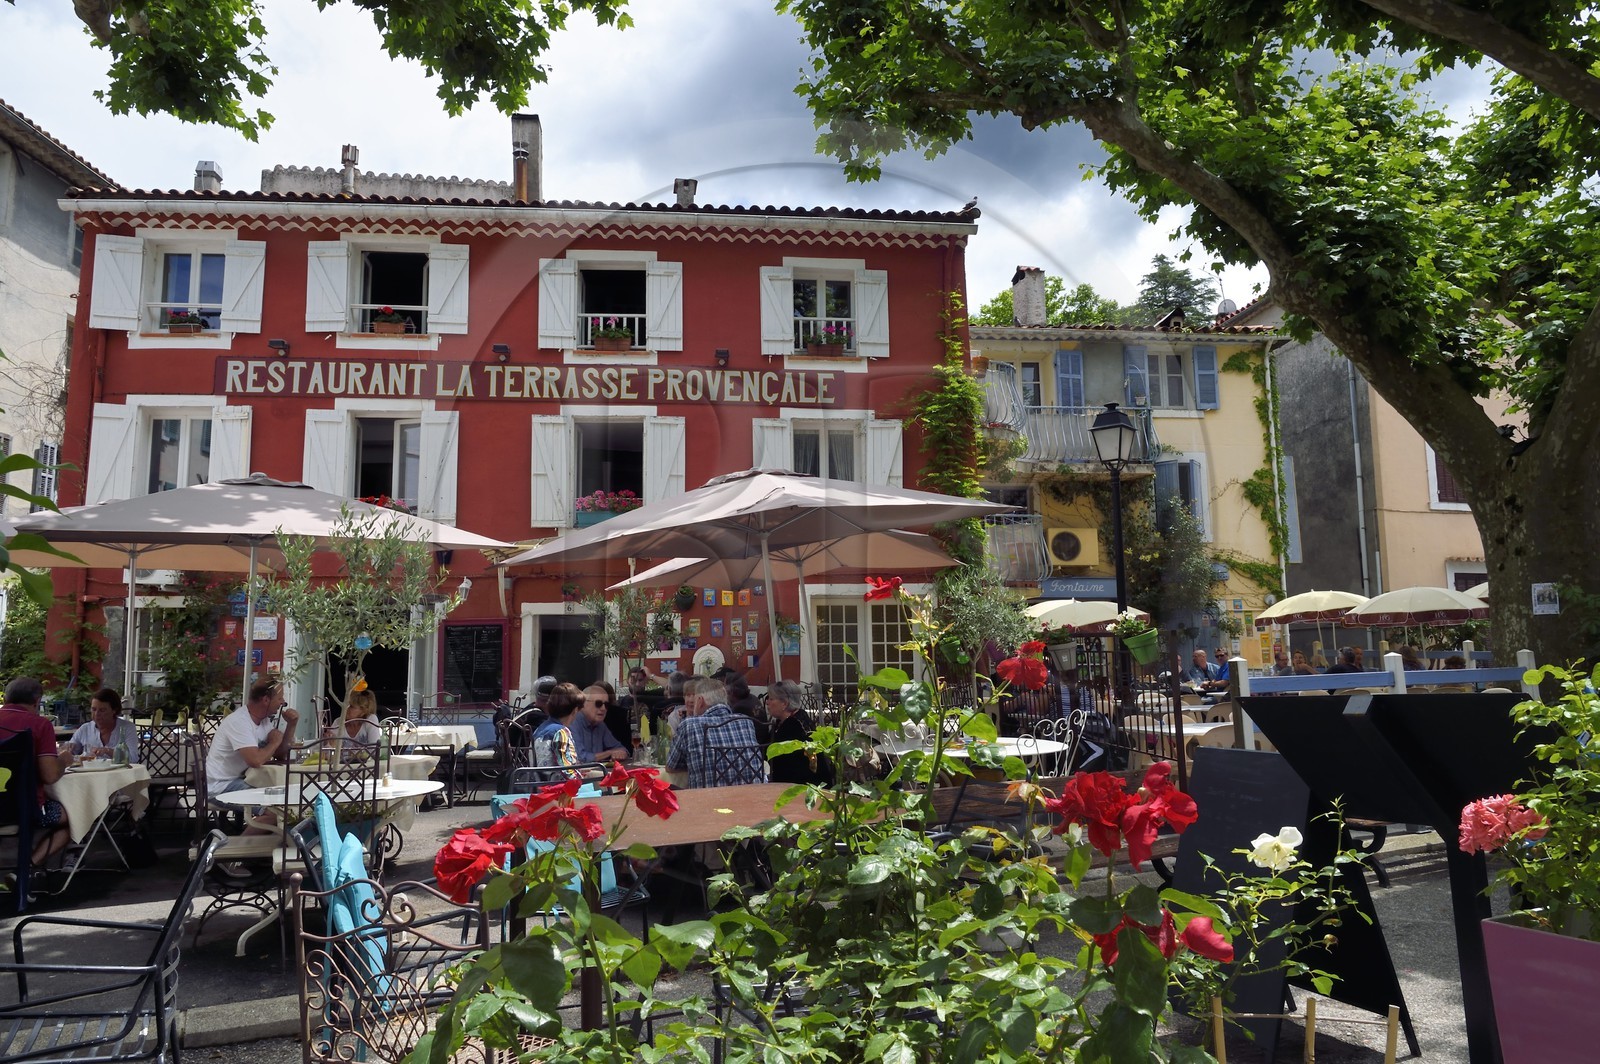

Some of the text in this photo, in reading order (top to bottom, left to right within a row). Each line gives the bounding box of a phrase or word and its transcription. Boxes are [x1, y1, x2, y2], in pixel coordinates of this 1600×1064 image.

[224, 360, 835, 406] RESTAURANT LA TERRASSE PROVENÇALE
[1050, 580, 1105, 592] Fontaine
